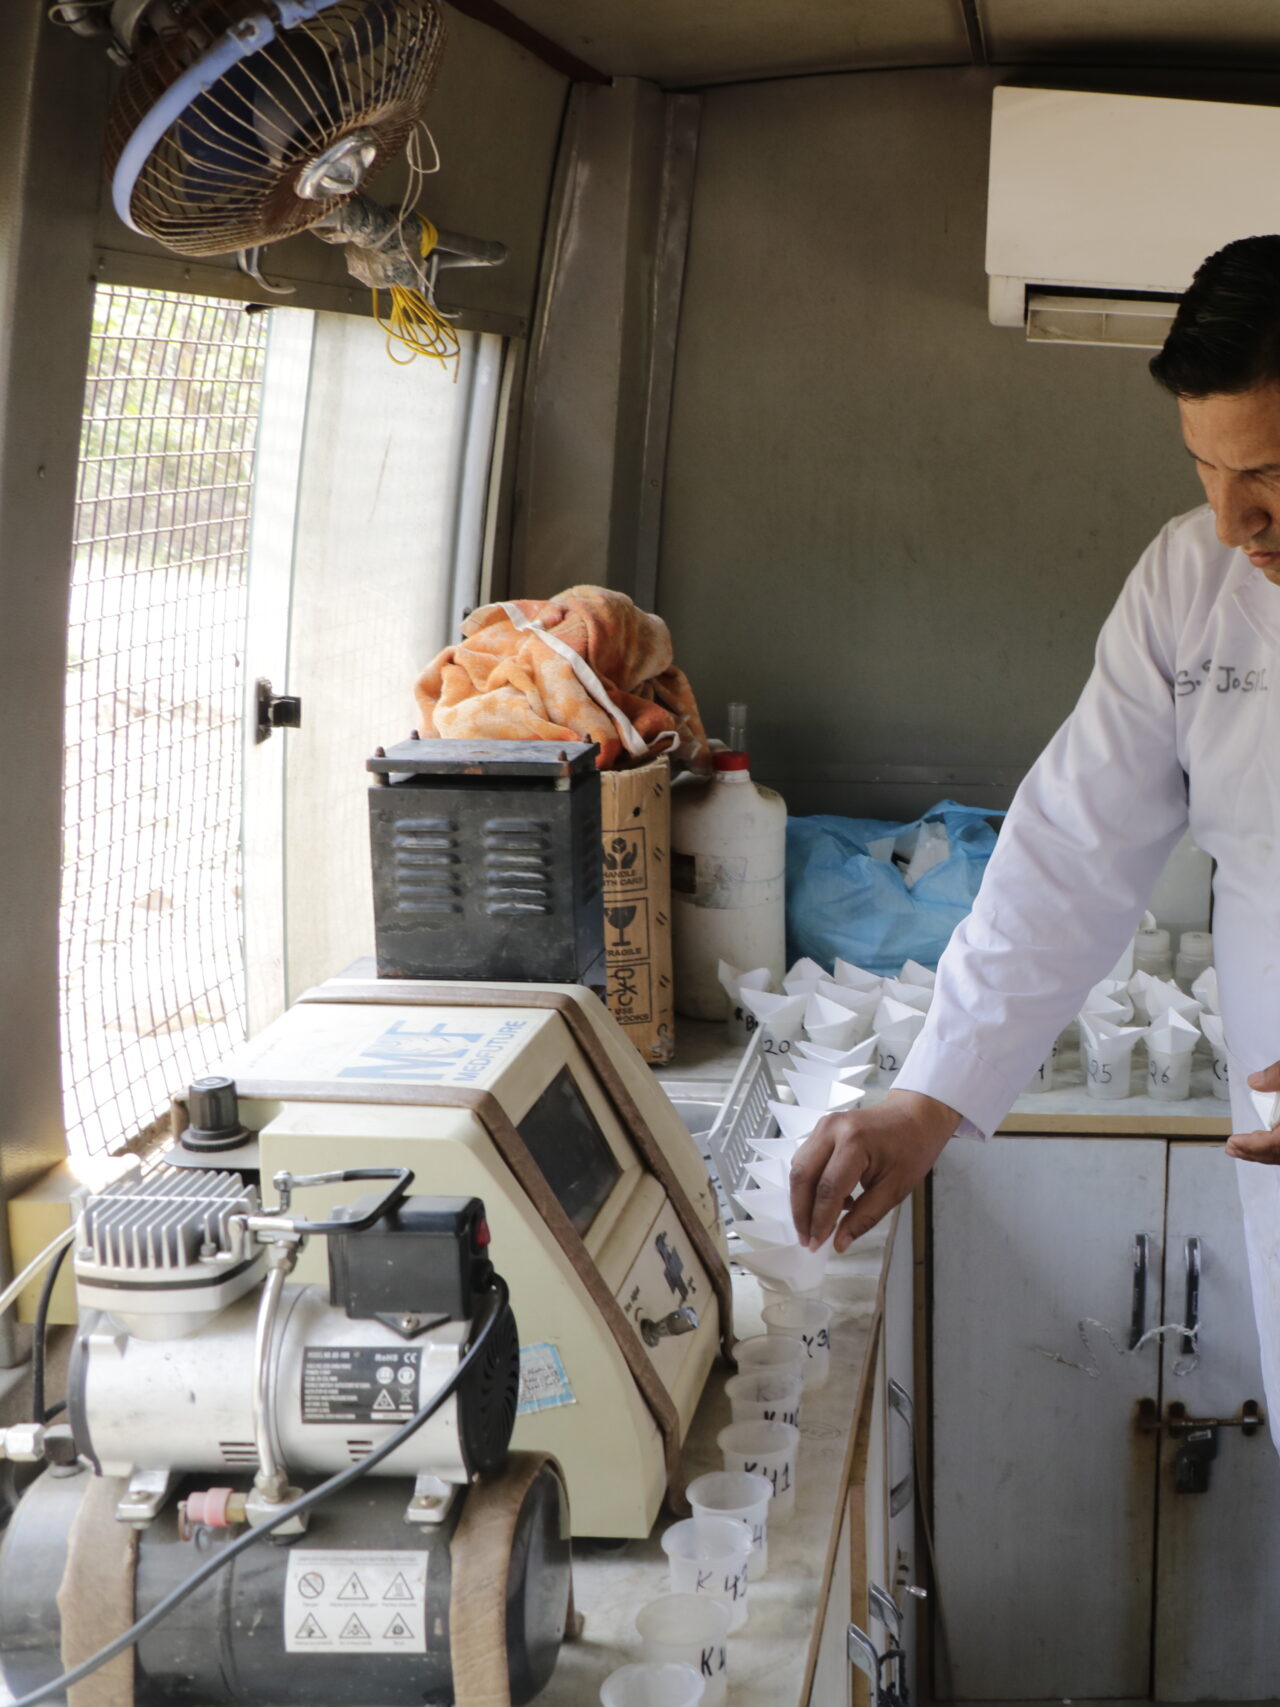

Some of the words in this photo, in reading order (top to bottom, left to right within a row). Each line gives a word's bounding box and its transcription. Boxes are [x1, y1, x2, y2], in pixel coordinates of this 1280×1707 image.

[606, 946, 642, 957] RAGILE
[452, 1020, 528, 1081] MEDFUTURE
[763, 1039, 791, 1056] 20
[879, 1054, 899, 1071] 22
